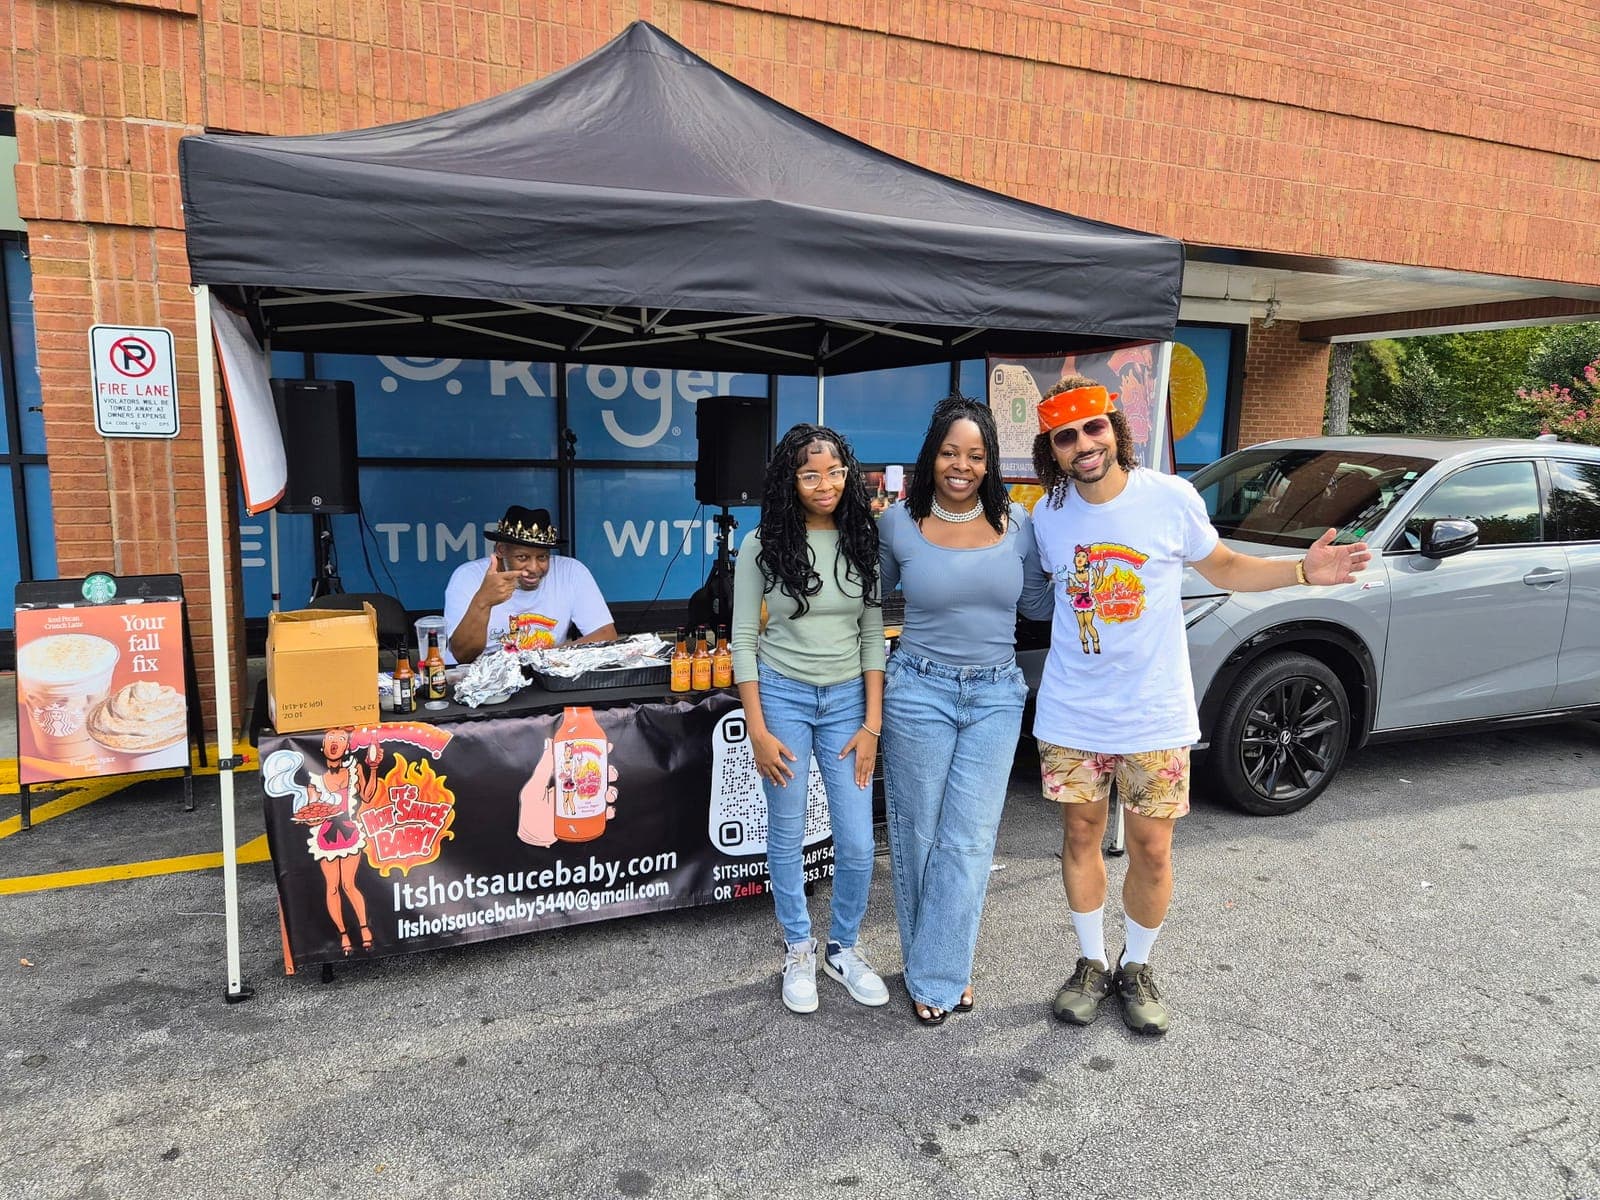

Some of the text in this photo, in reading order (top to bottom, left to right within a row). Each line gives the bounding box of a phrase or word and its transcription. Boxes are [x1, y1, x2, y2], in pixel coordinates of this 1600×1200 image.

[99, 383, 169, 397] FIRE LANE
[490, 360, 744, 448] Kroger
[602, 519, 734, 557] WITH
[120, 614, 165, 632] Your
[128, 633, 161, 652] fall
[132, 655, 159, 673] fix
[389, 784, 419, 801] IT'S
[361, 798, 451, 837] HOT SAUCE
[375, 823, 440, 860] BABY!
[393, 851, 677, 912] Itshotsaucebaby.com
[713, 885, 732, 901] OR
[734, 881, 763, 898] Zelle
[398, 880, 670, 939] Itshotsaucebaby5440@gmail.com
